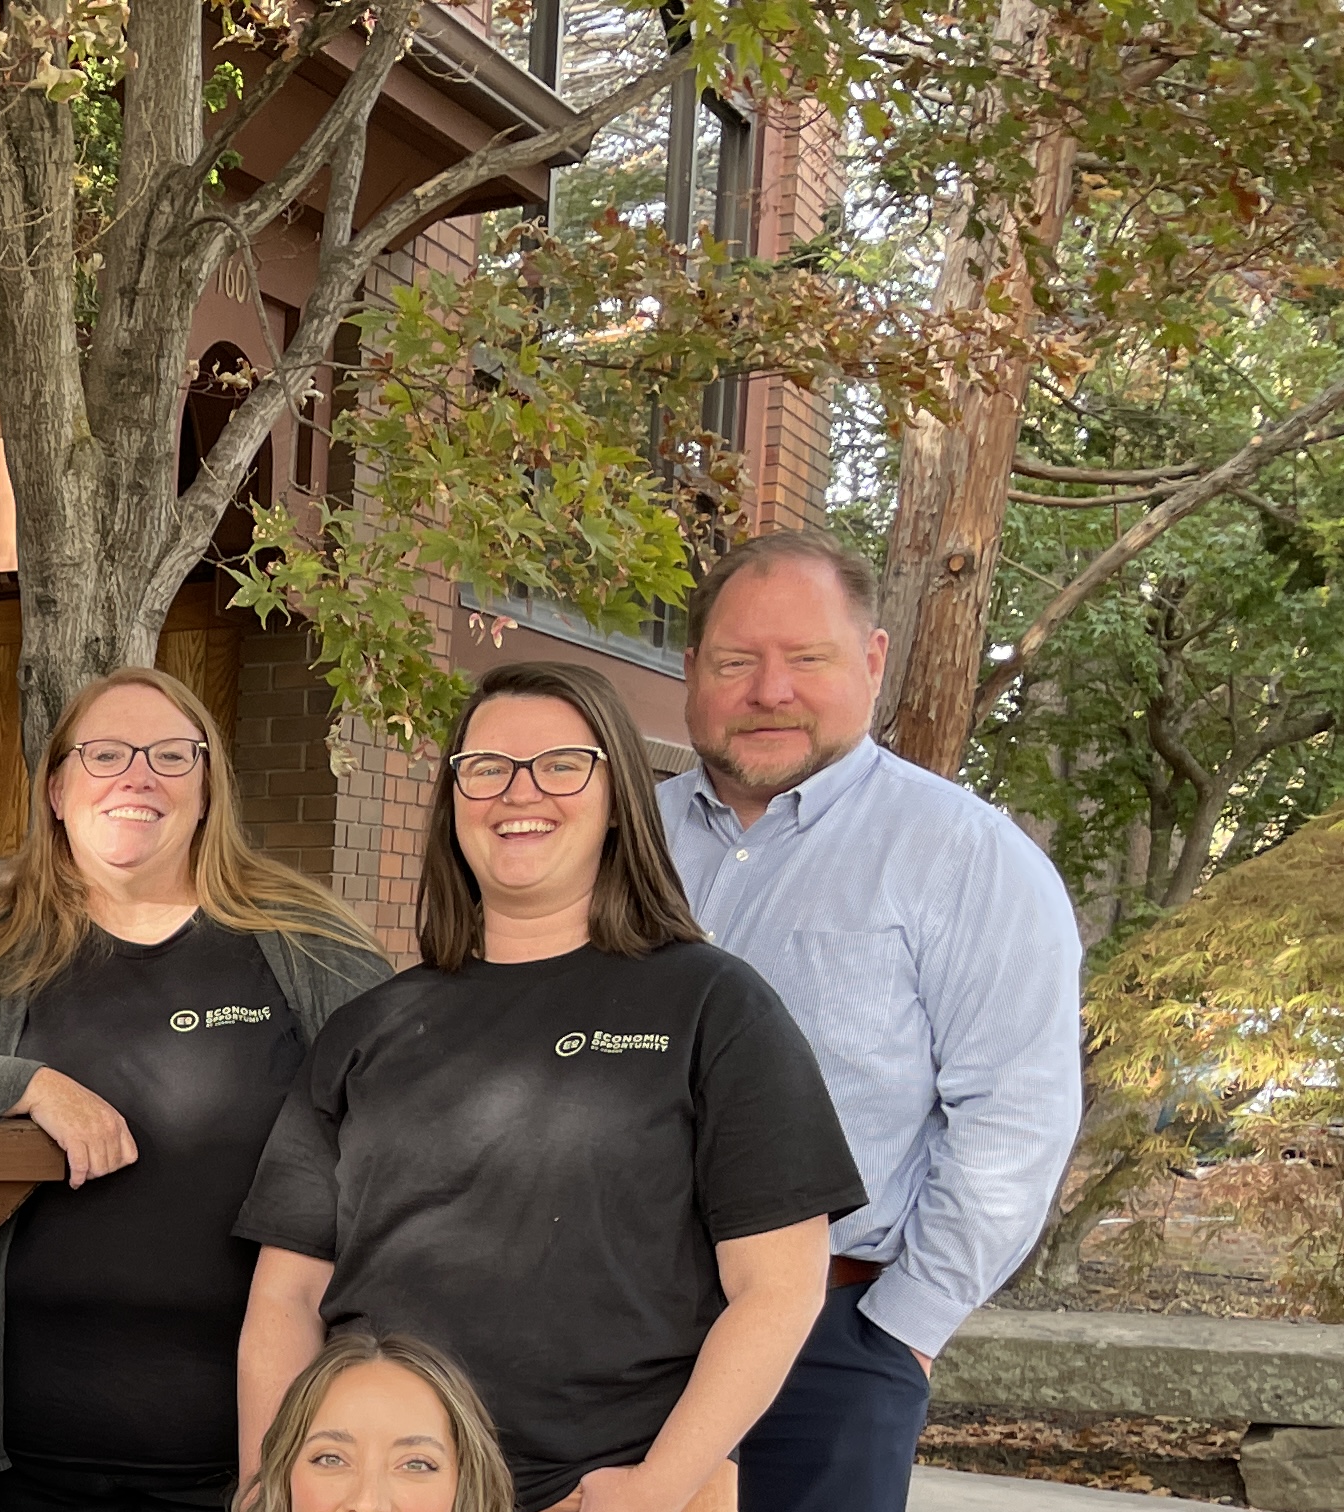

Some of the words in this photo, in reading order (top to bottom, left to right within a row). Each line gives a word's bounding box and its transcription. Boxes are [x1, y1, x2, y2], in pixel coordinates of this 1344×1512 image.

[205, 1012, 271, 1024] OPPORTUNITY
[206, 1006, 270, 1018] ECONOMIC
[593, 1030, 670, 1045] ECONOMIC
